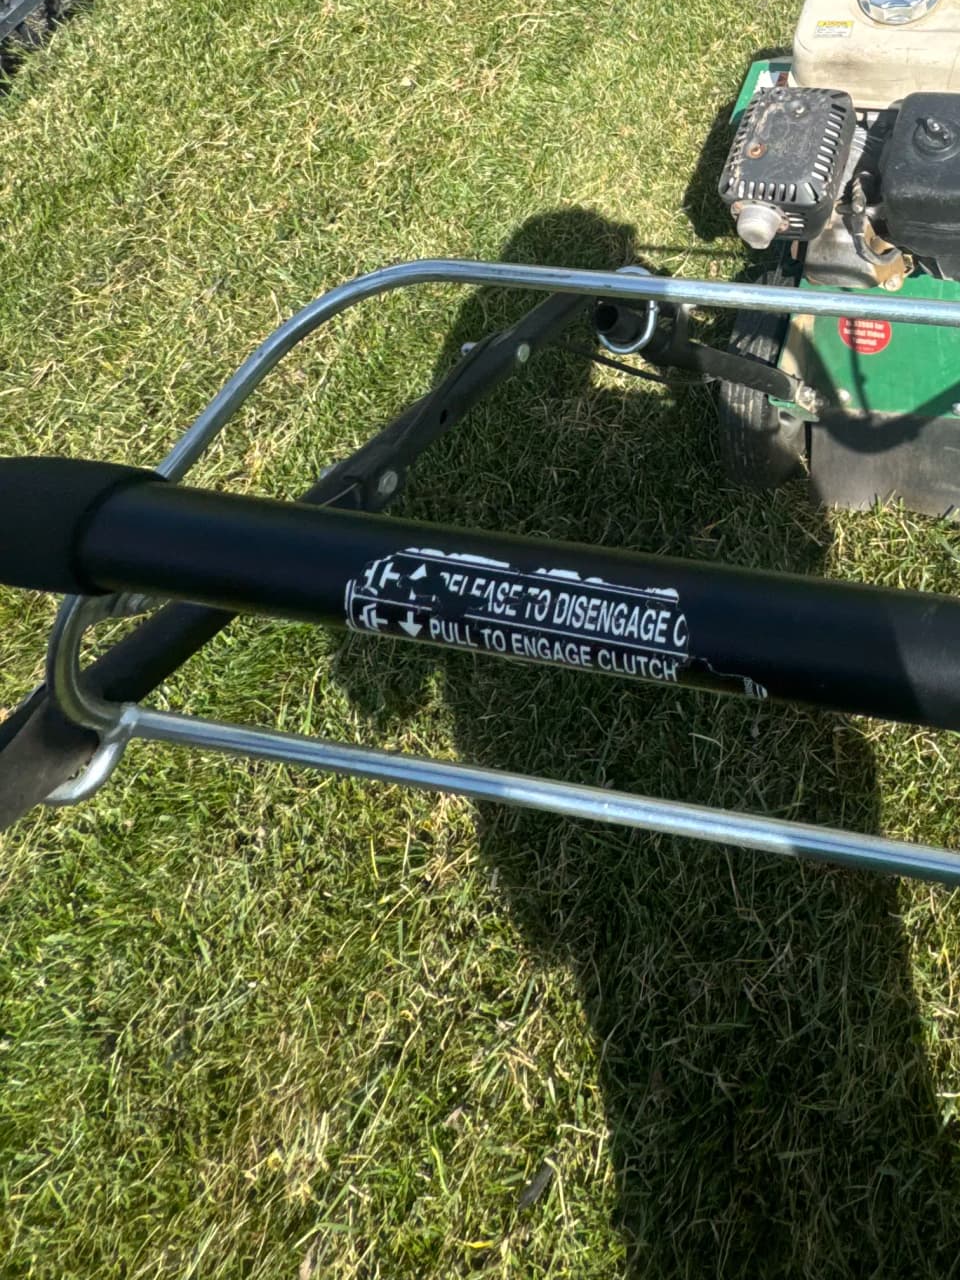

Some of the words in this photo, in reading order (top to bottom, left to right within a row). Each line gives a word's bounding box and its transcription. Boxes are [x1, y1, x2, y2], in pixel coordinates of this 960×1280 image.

[525, 586, 551, 621] TO
[553, 592, 671, 644] DISENGAGE
[429, 619, 478, 648] PULL
[480, 628, 506, 652] TO
[511, 633, 593, 667] ENGAGE
[598, 650, 679, 682] CLUTCH
